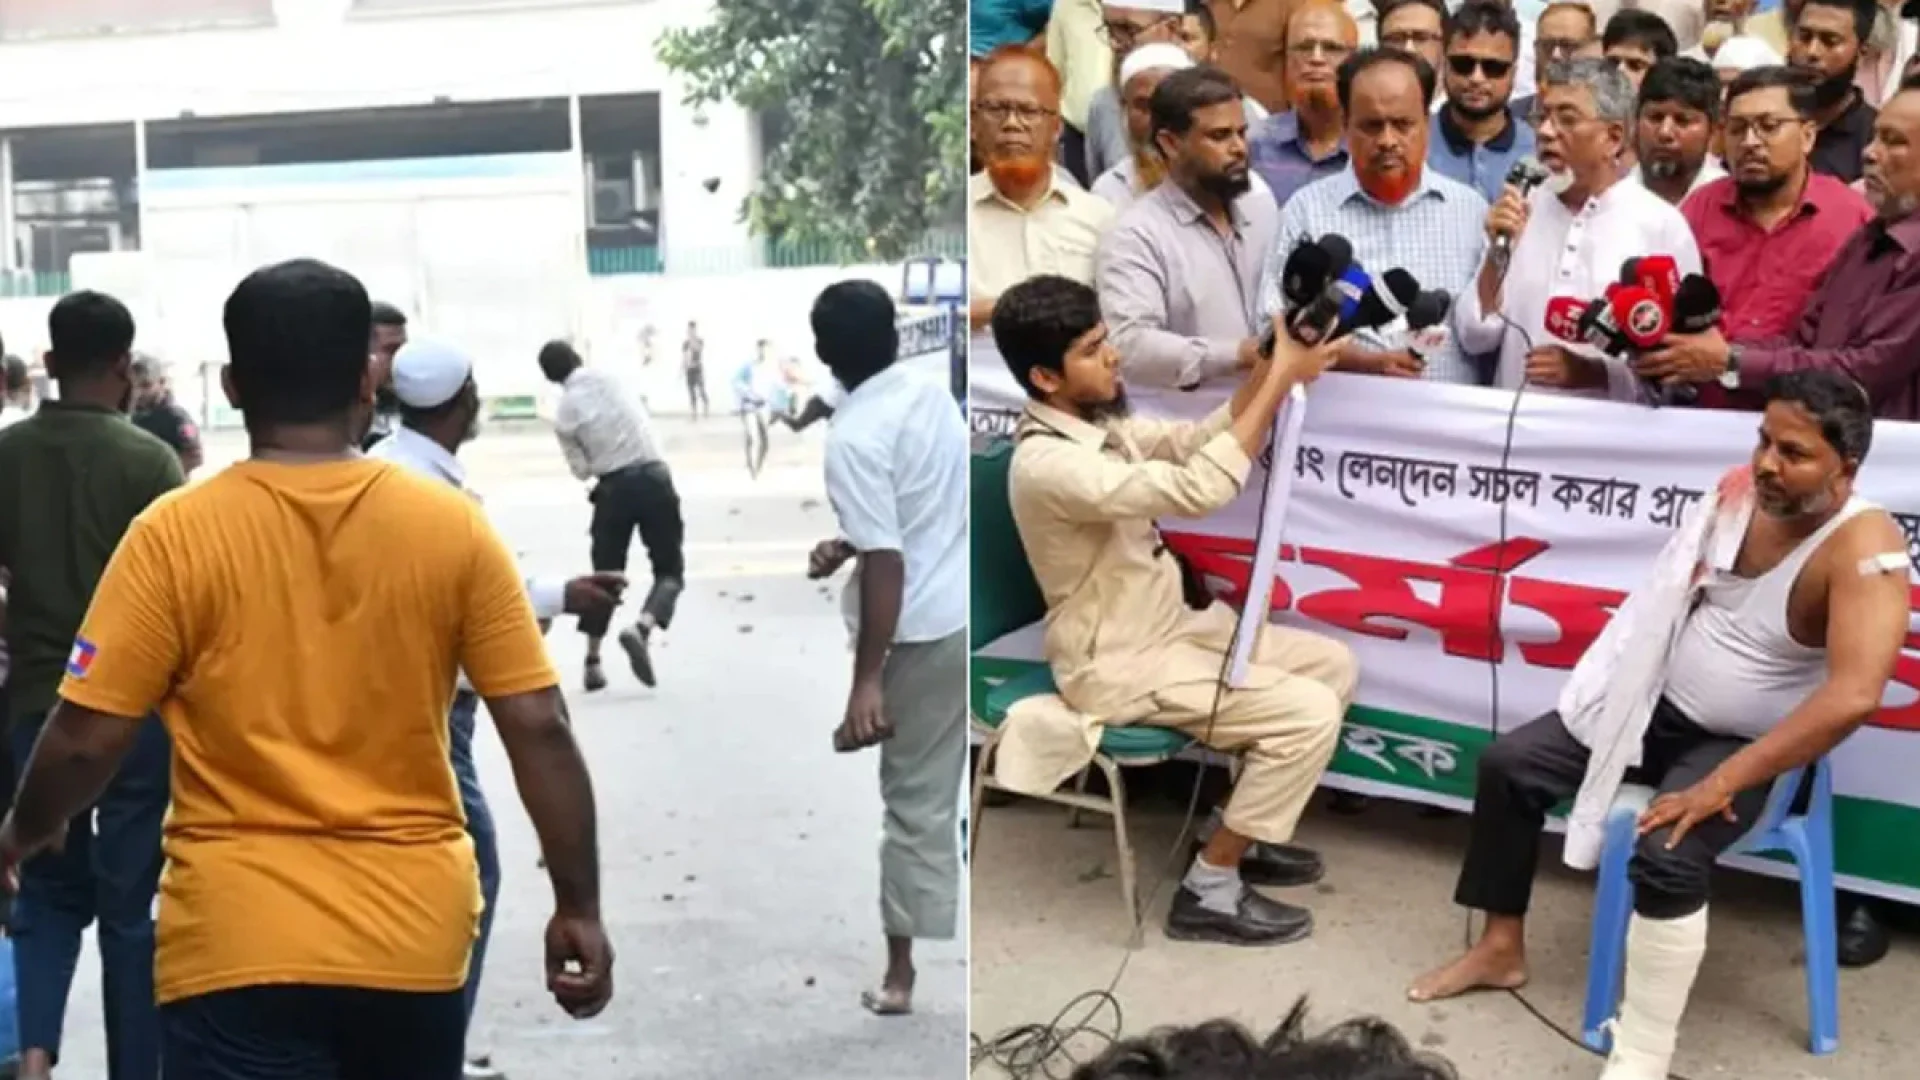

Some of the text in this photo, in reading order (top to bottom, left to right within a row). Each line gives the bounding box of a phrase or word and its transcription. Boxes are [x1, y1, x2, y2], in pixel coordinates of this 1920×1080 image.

[1338, 451, 1459, 507] লেনদেন
[1467, 465, 1542, 507] সচল
[1552, 474, 1641, 519] করার
[1342, 722, 1463, 780] হক
